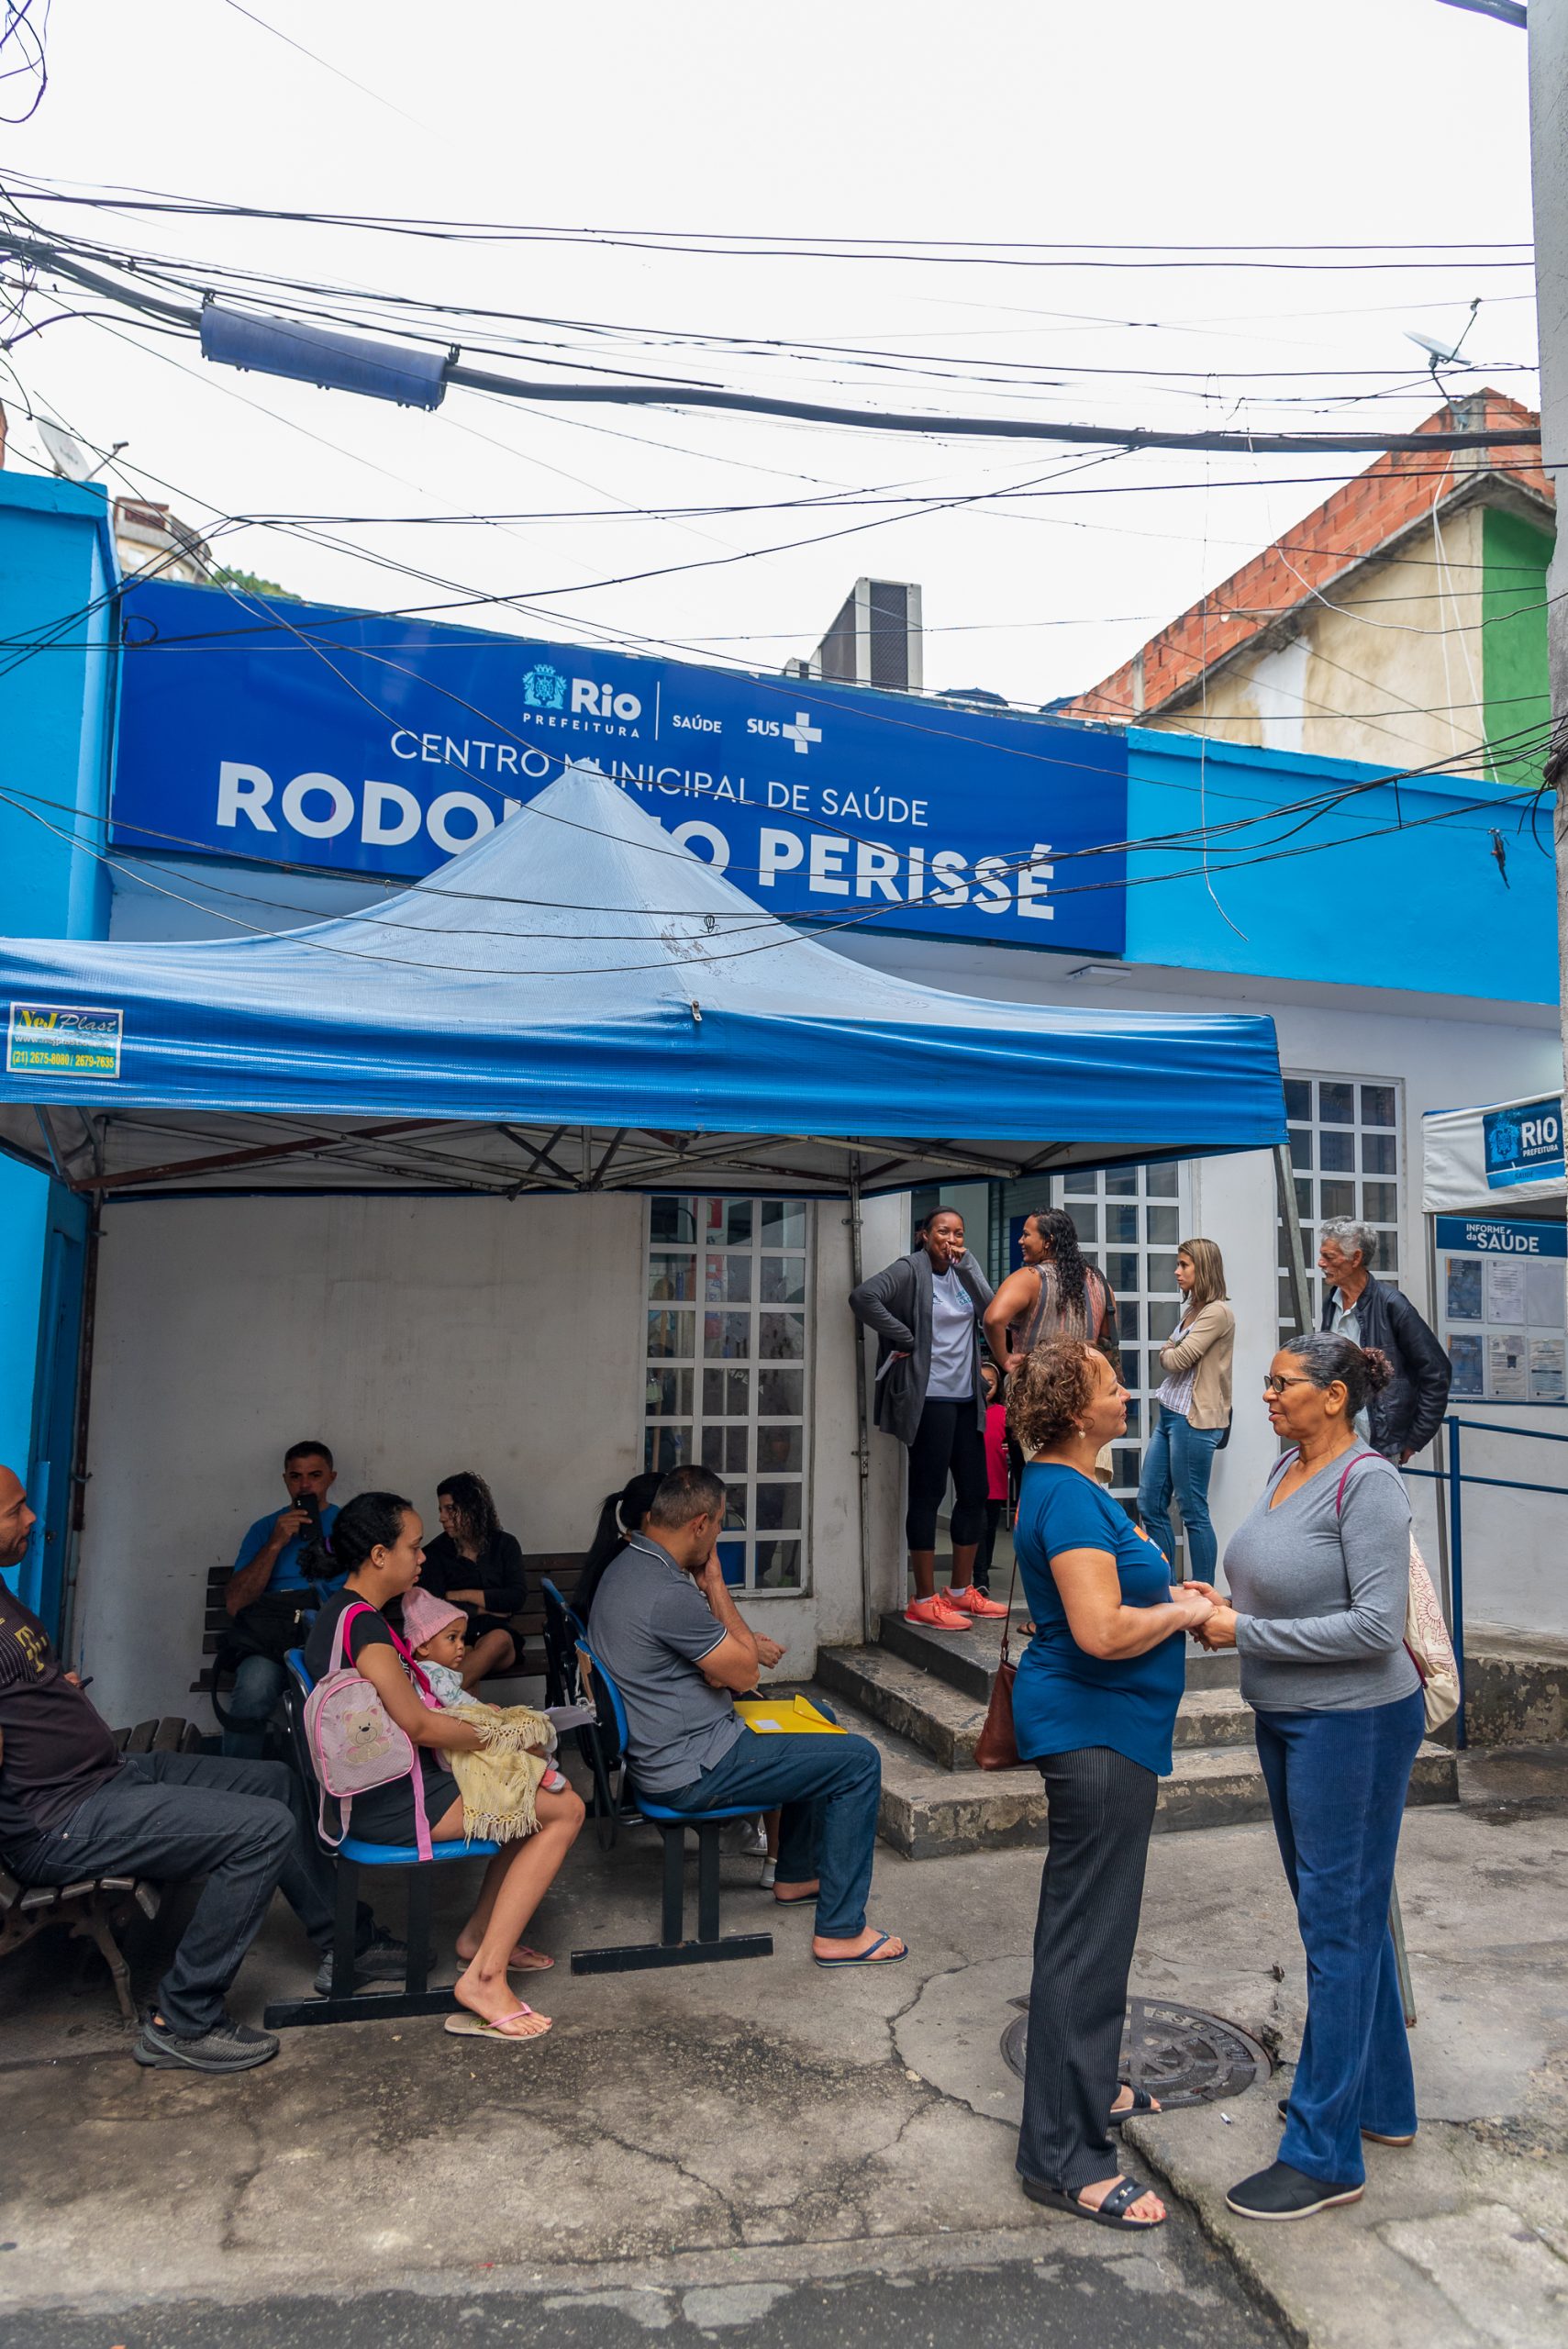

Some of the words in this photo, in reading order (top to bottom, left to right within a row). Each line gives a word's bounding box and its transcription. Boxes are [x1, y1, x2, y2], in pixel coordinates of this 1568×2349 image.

[571, 678, 642, 721] Rio
[523, 713, 639, 738] PREFEITURA
[673, 714, 722, 733] SAÚDE
[747, 718, 780, 736] SUS
[391, 729, 550, 777] CENTRO
[768, 781, 810, 812] DE
[821, 786, 929, 827] SAÚDE
[759, 827, 1054, 920] PERISSÉ
[59, 1013, 117, 1032] Plast
[12, 1051, 28, 1066] (21)
[1520, 1117, 1558, 1148] RIO
[1522, 1143, 1559, 1157] PREFEITURA
[1466, 1223, 1505, 1234] INFORME
[1466, 1233, 1477, 1241] da
[1477, 1230, 1540, 1252] SAÚDE
